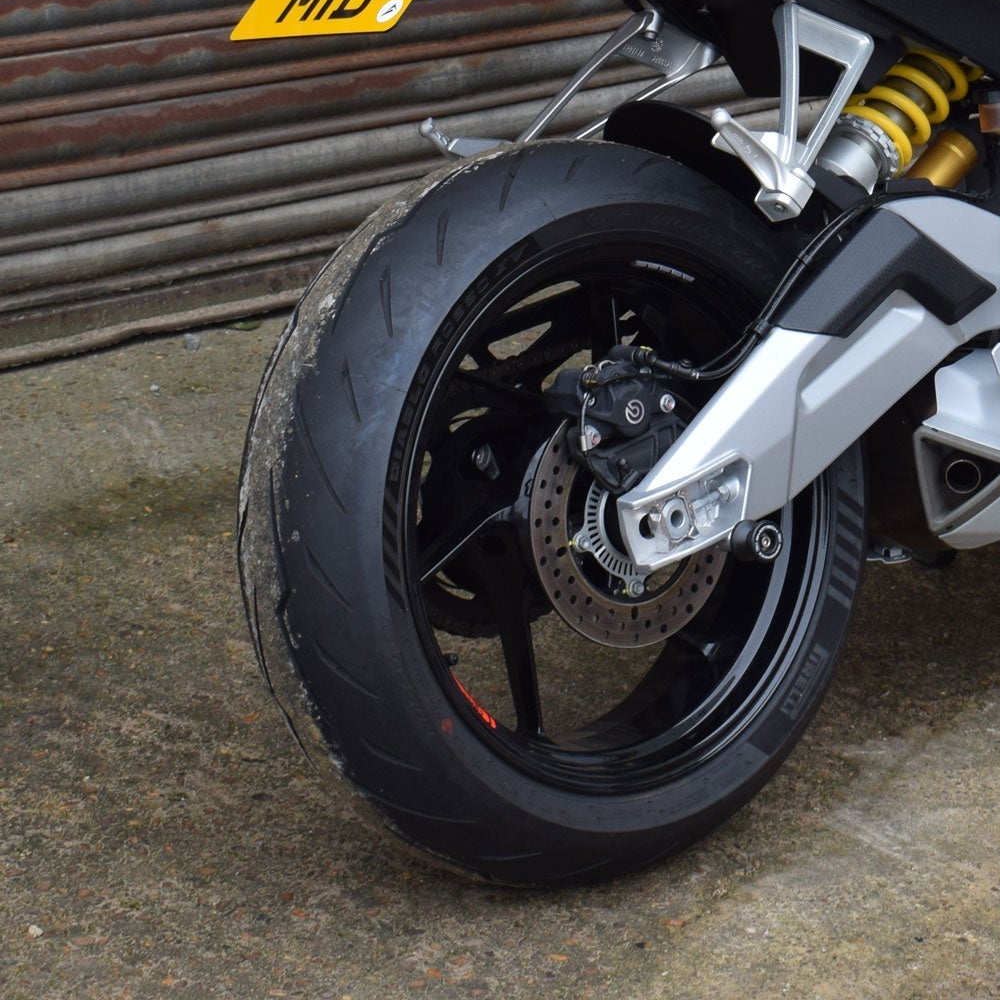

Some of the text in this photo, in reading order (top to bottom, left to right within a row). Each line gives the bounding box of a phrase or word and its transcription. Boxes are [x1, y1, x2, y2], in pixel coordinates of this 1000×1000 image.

[389, 363, 431, 482] DIABLO
[432, 275, 490, 356] ROSSO
[780, 643, 831, 721] PIRELLI
